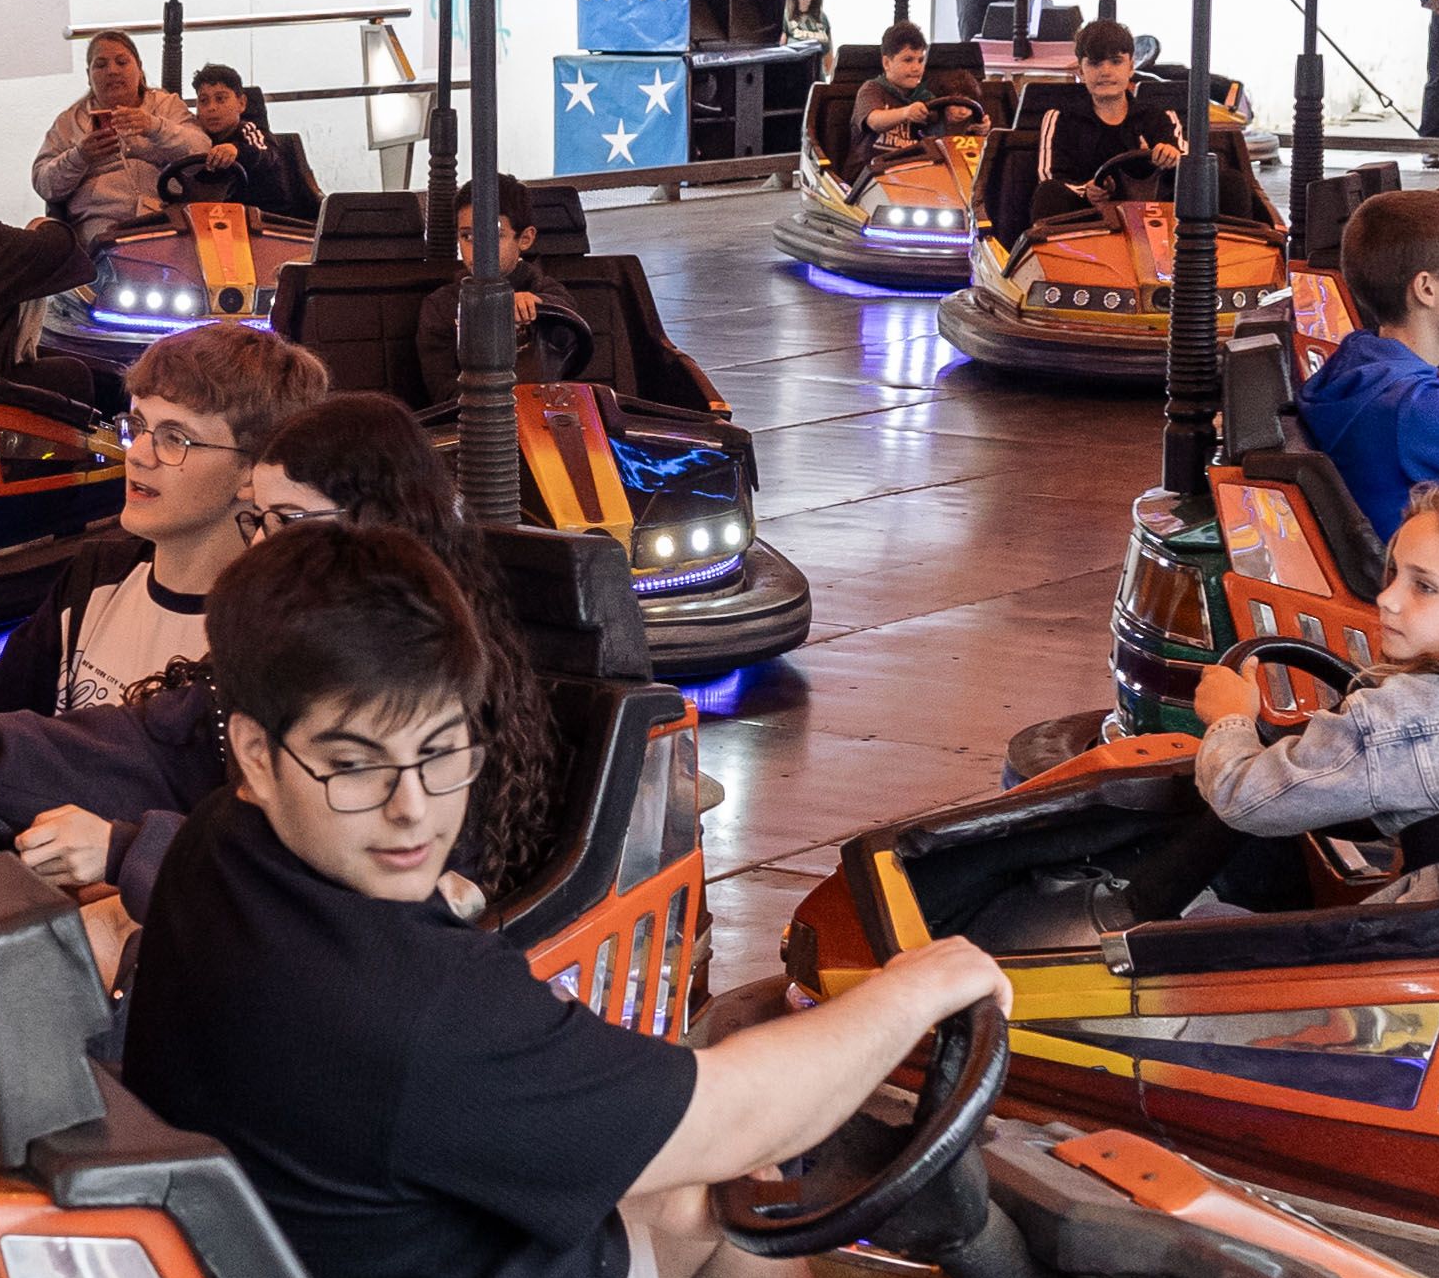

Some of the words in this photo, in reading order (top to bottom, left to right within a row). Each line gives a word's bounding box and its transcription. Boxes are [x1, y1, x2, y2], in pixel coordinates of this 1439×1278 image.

[1144, 201, 1163, 218] 5
[81, 659, 94, 670] NEW
[94, 668, 107, 679] YORK
[106, 675, 119, 685] CITY
